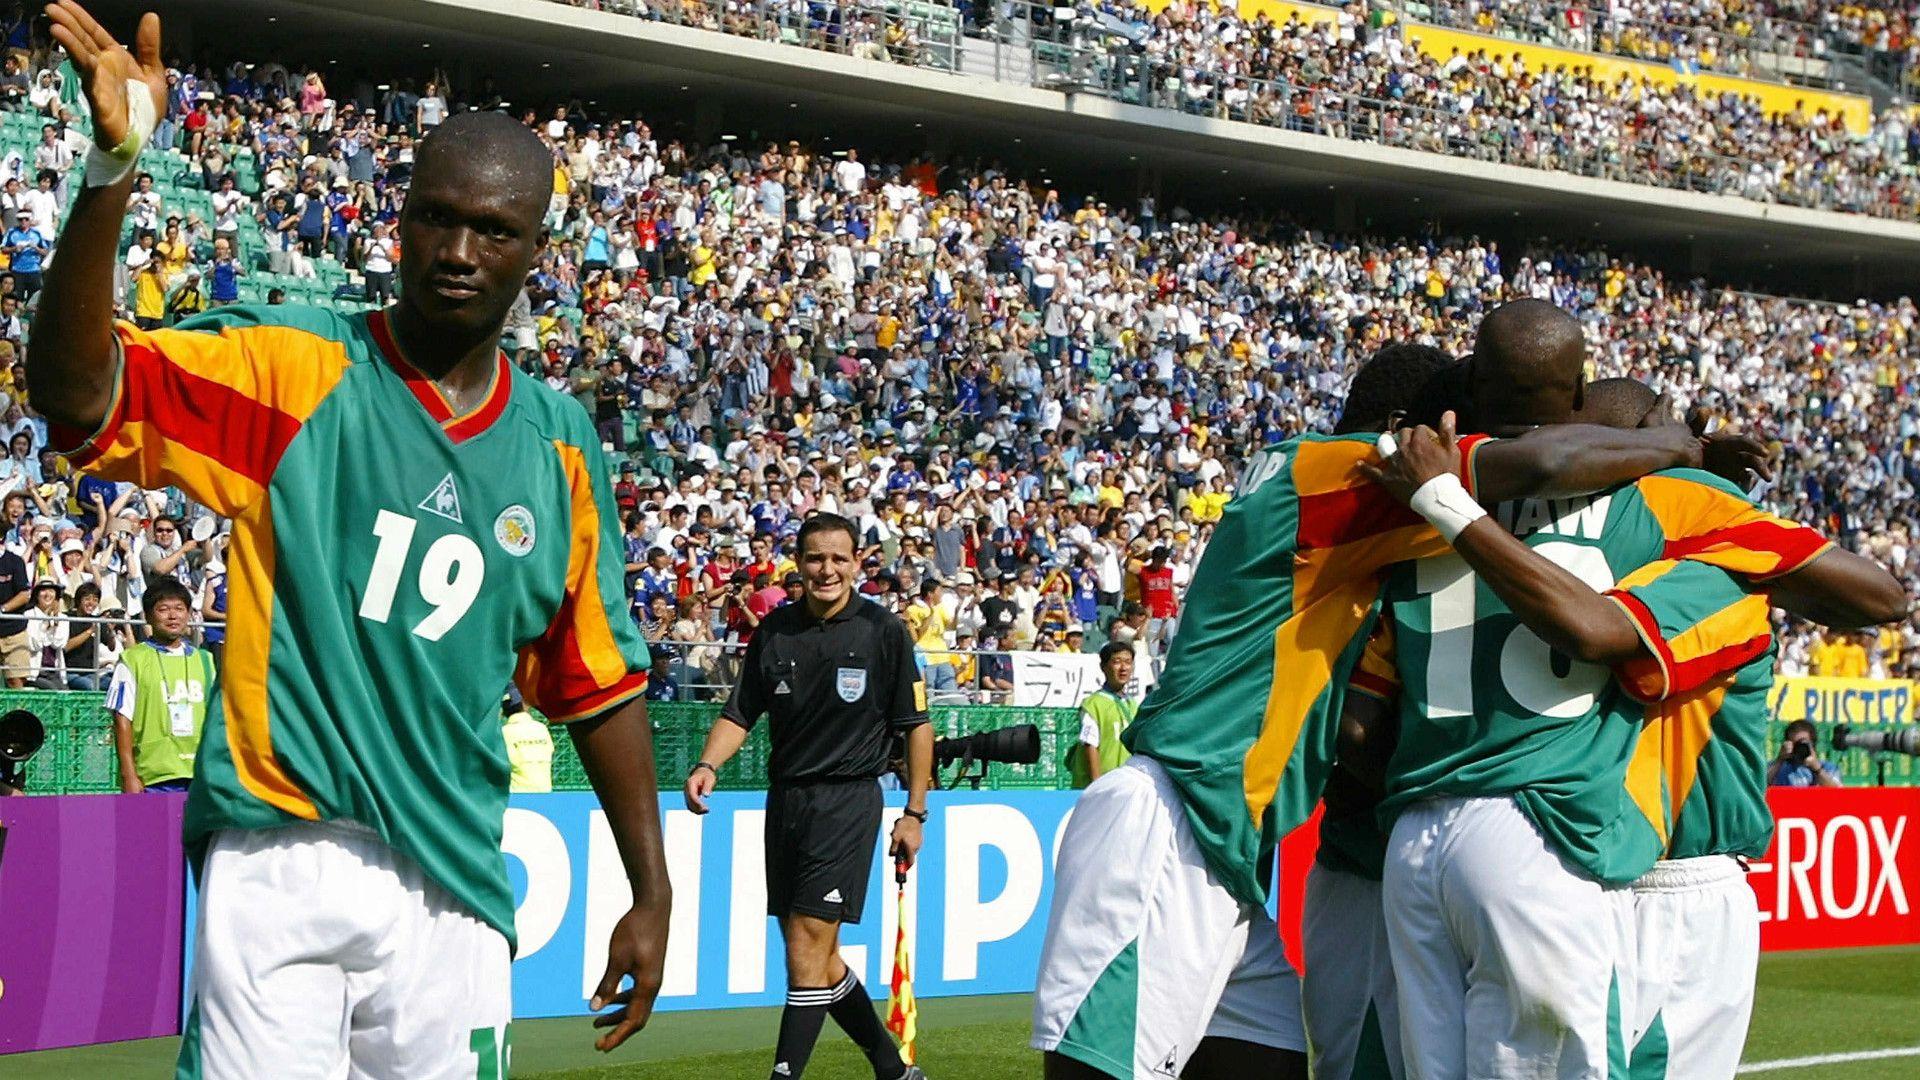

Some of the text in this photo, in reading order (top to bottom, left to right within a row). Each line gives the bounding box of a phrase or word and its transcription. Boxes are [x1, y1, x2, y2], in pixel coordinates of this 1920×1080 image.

[358, 508, 485, 642] 19
[160, 679, 204, 704] LAB
[500, 803, 1075, 1000] PHIIP
